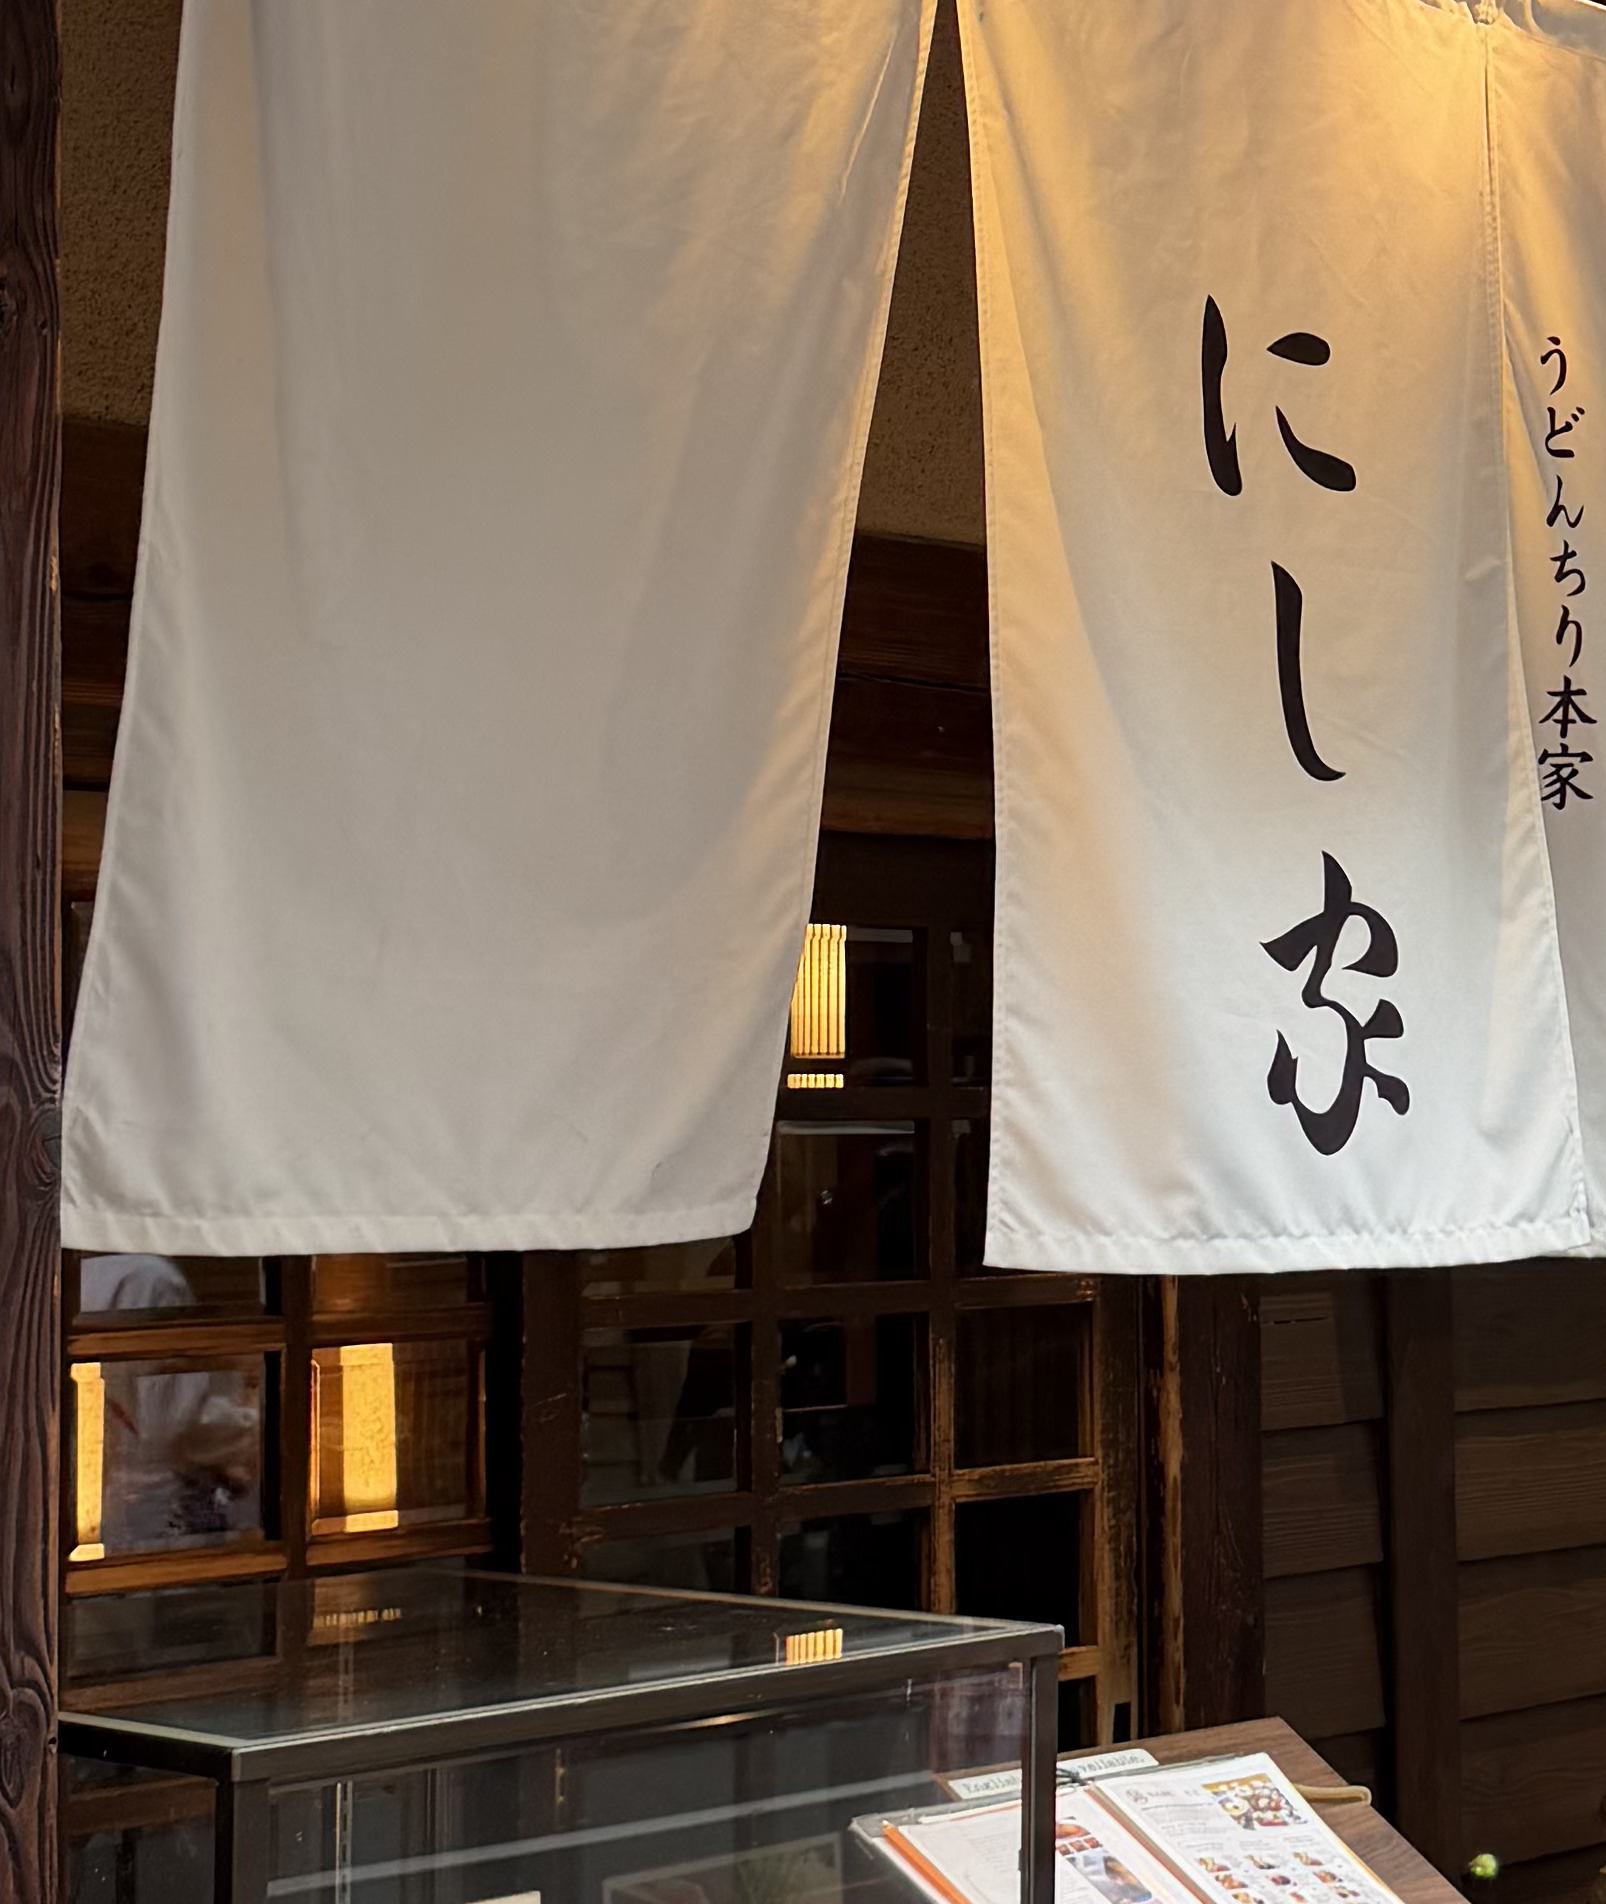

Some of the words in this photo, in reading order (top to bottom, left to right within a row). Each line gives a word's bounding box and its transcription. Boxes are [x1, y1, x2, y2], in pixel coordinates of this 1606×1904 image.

[1200, 294, 1410, 1156] にし家
[1538, 335, 1598, 811] うどんちり本家
